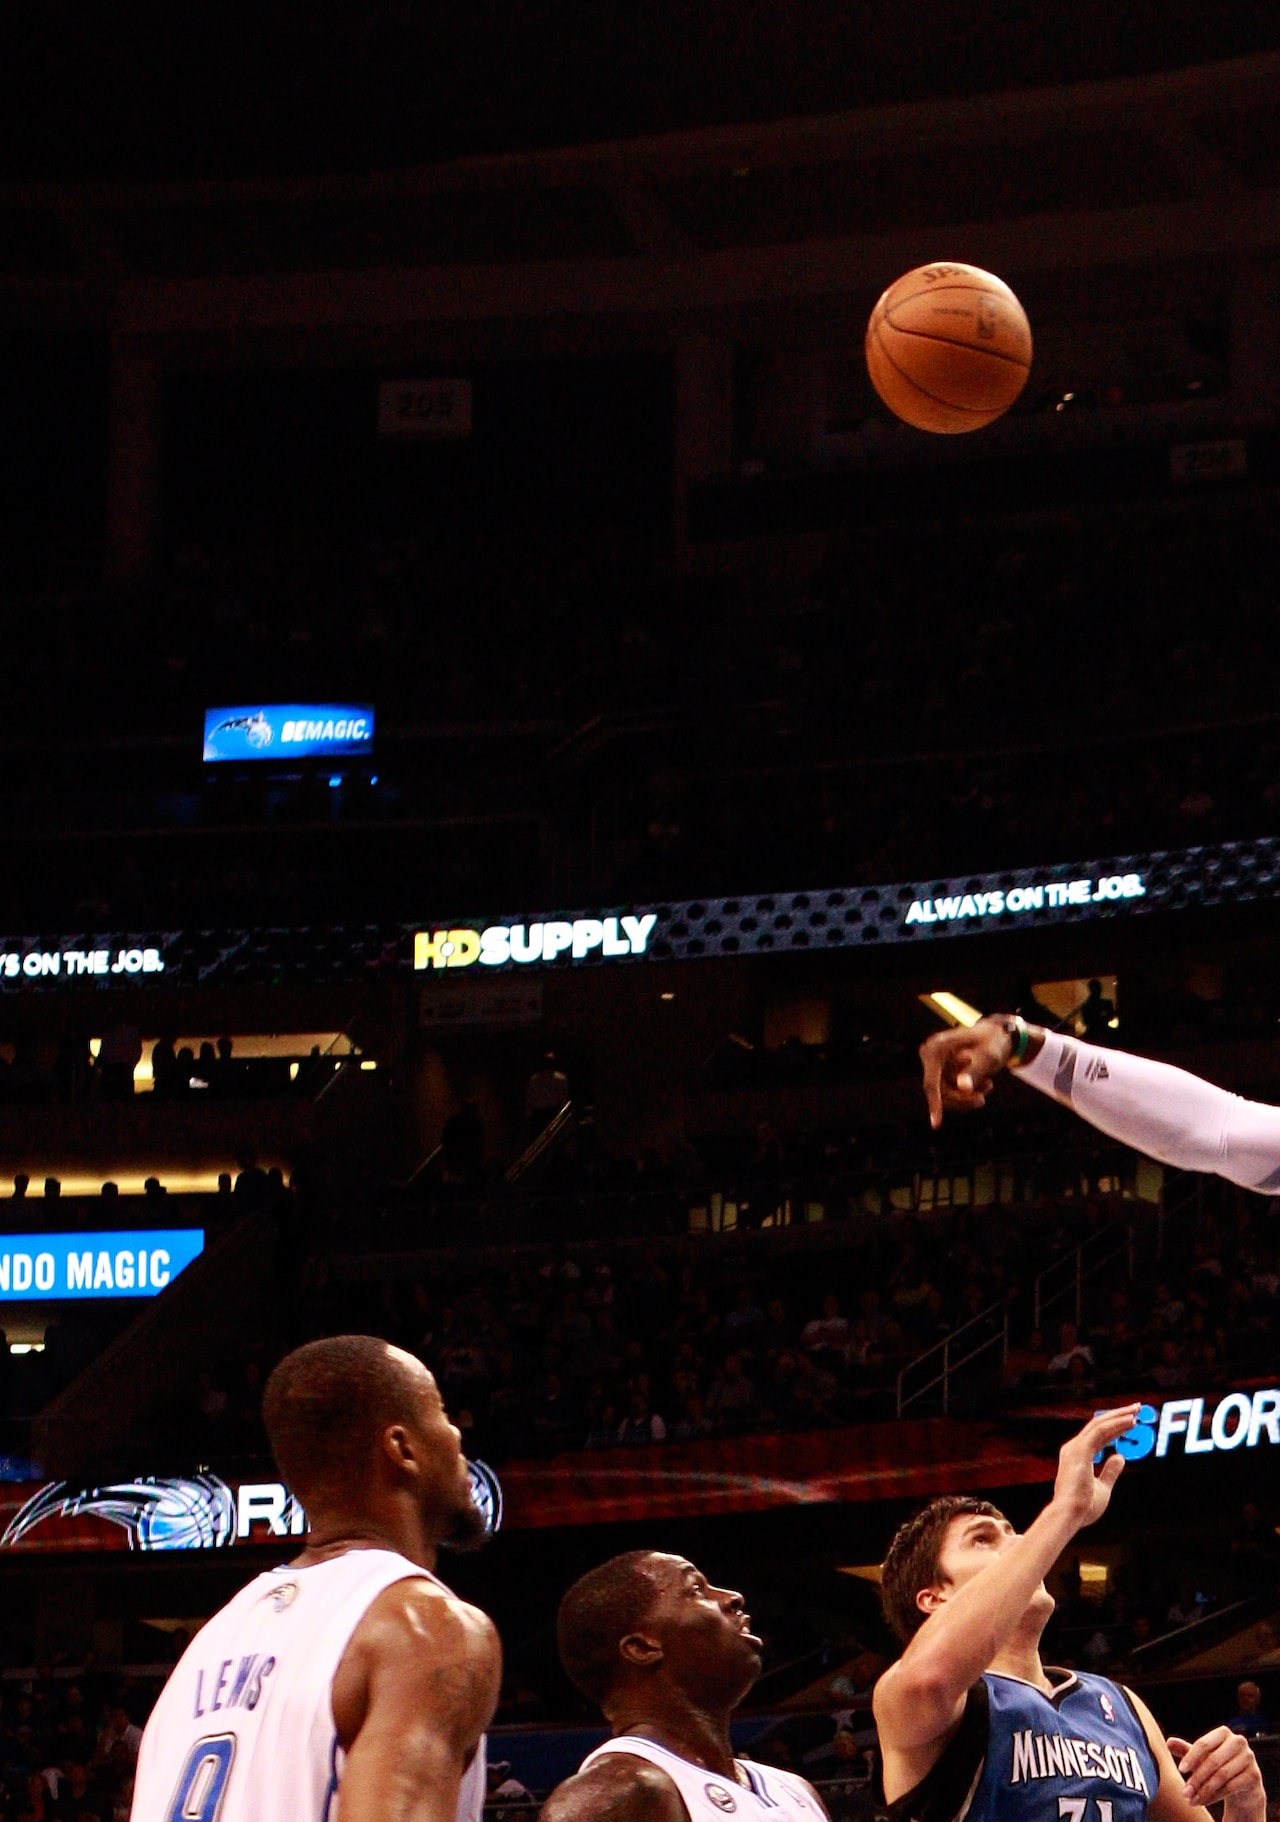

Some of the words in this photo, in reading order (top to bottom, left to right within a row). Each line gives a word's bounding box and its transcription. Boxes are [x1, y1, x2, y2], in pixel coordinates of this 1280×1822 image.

[905, 890, 1005, 924] ALWAYS
[1006, 886, 1043, 912] ON
[1046, 879, 1092, 908] THE
[23, 952, 61, 976] ON
[63, 950, 110, 975] THE
[67, 1249, 171, 1290] MAGIC
[1011, 1728, 1150, 1800] MINNESOTA
